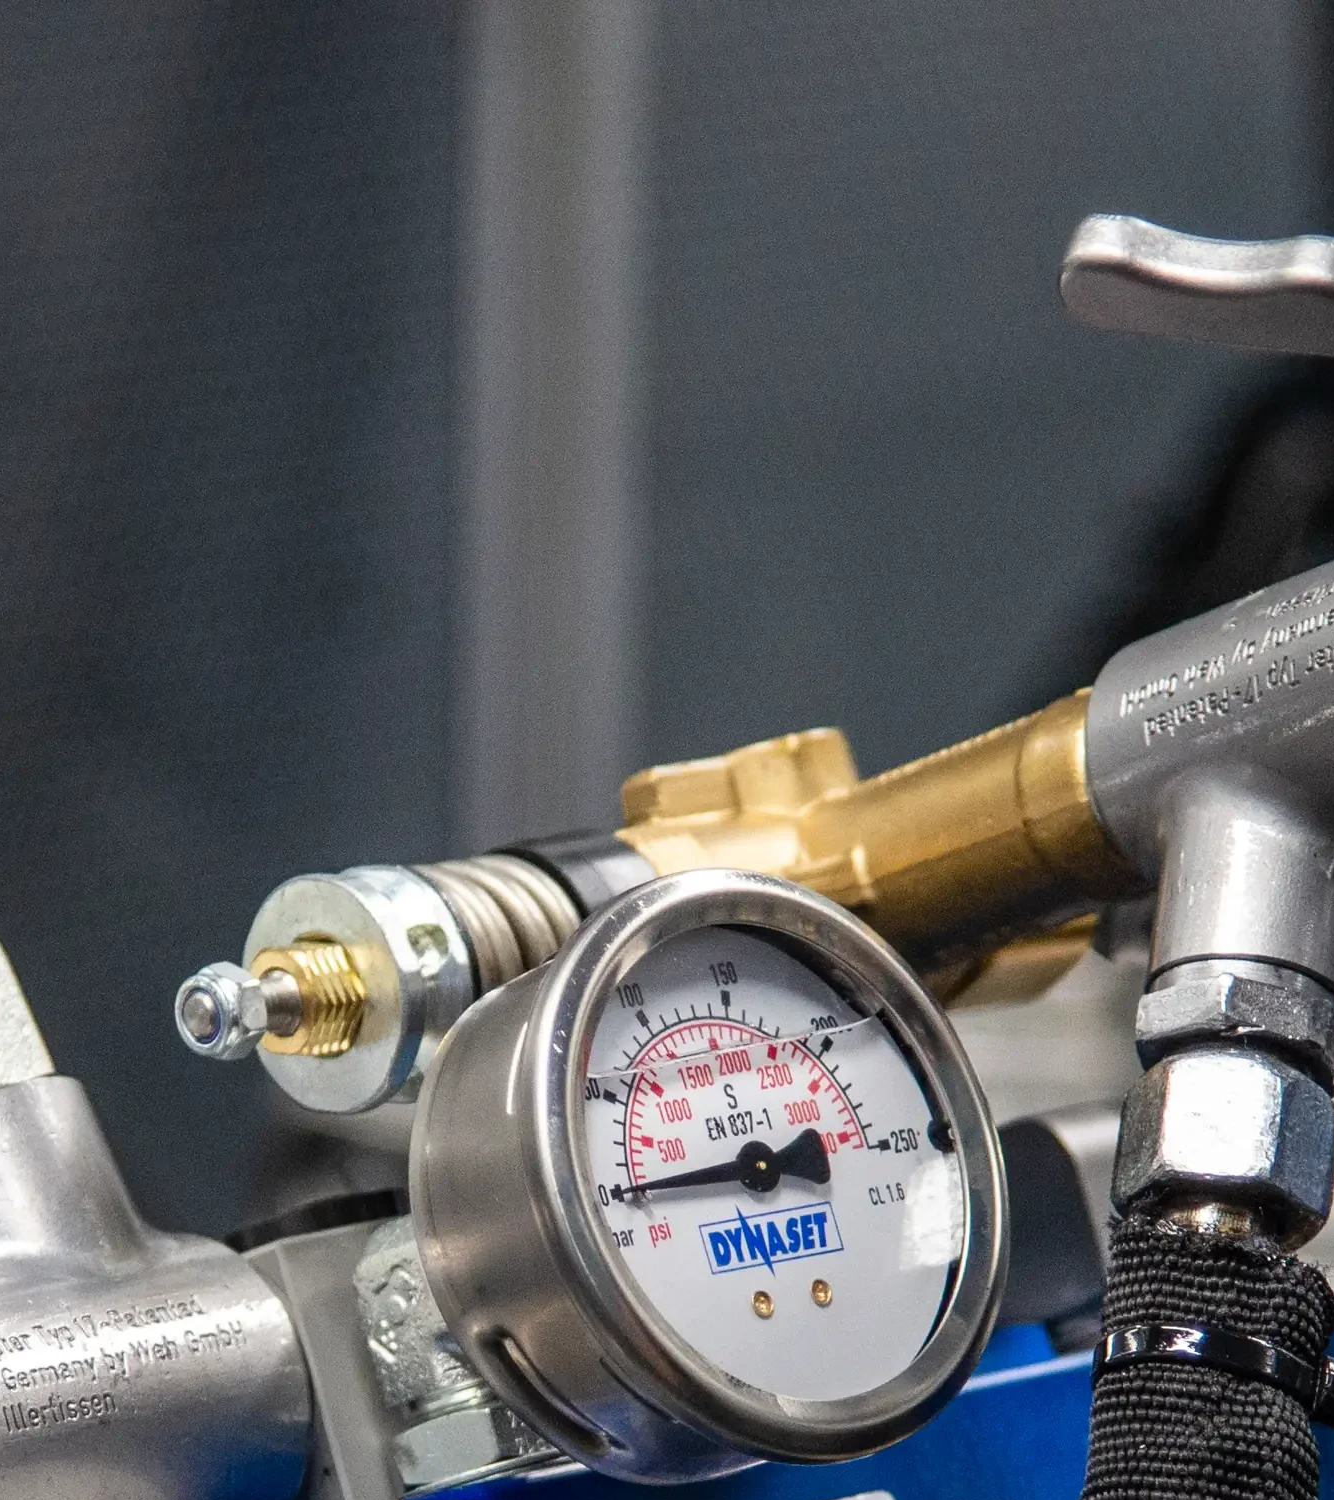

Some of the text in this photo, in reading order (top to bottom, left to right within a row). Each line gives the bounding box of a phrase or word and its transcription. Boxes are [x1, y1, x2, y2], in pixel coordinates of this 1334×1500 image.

[1231, 638, 1257, 665] by
[1267, 655, 1302, 689] Typ
[709, 960, 738, 987] 150
[615, 982, 644, 1009] 100
[677, 1063, 714, 1090] 1500
[715, 1050, 752, 1076] 2000
[756, 1063, 793, 1090] 2500
[723, 1083, 738, 1110] S
[655, 1097, 693, 1124] 1000
[705, 1107, 773, 1141] EN 837-1
[784, 1099, 821, 1126] 3000
[657, 1137, 686, 1163] 500
[890, 1128, 919, 1153] 250
[598, 1184, 610, 1207] 0
[868, 1182, 906, 1206] CL 1.6
[648, 1217, 672, 1249] psi
[708, 1205, 827, 1277] DYNASET
[31, 1324, 75, 1350] Typ
[0, 1356, 98, 1391] Germany
[100, 1347, 130, 1377] by
[128, 1336, 180, 1366] Weh
[183, 1320, 247, 1357] GmbH
[2, 1391, 119, 1434] Illertissen
